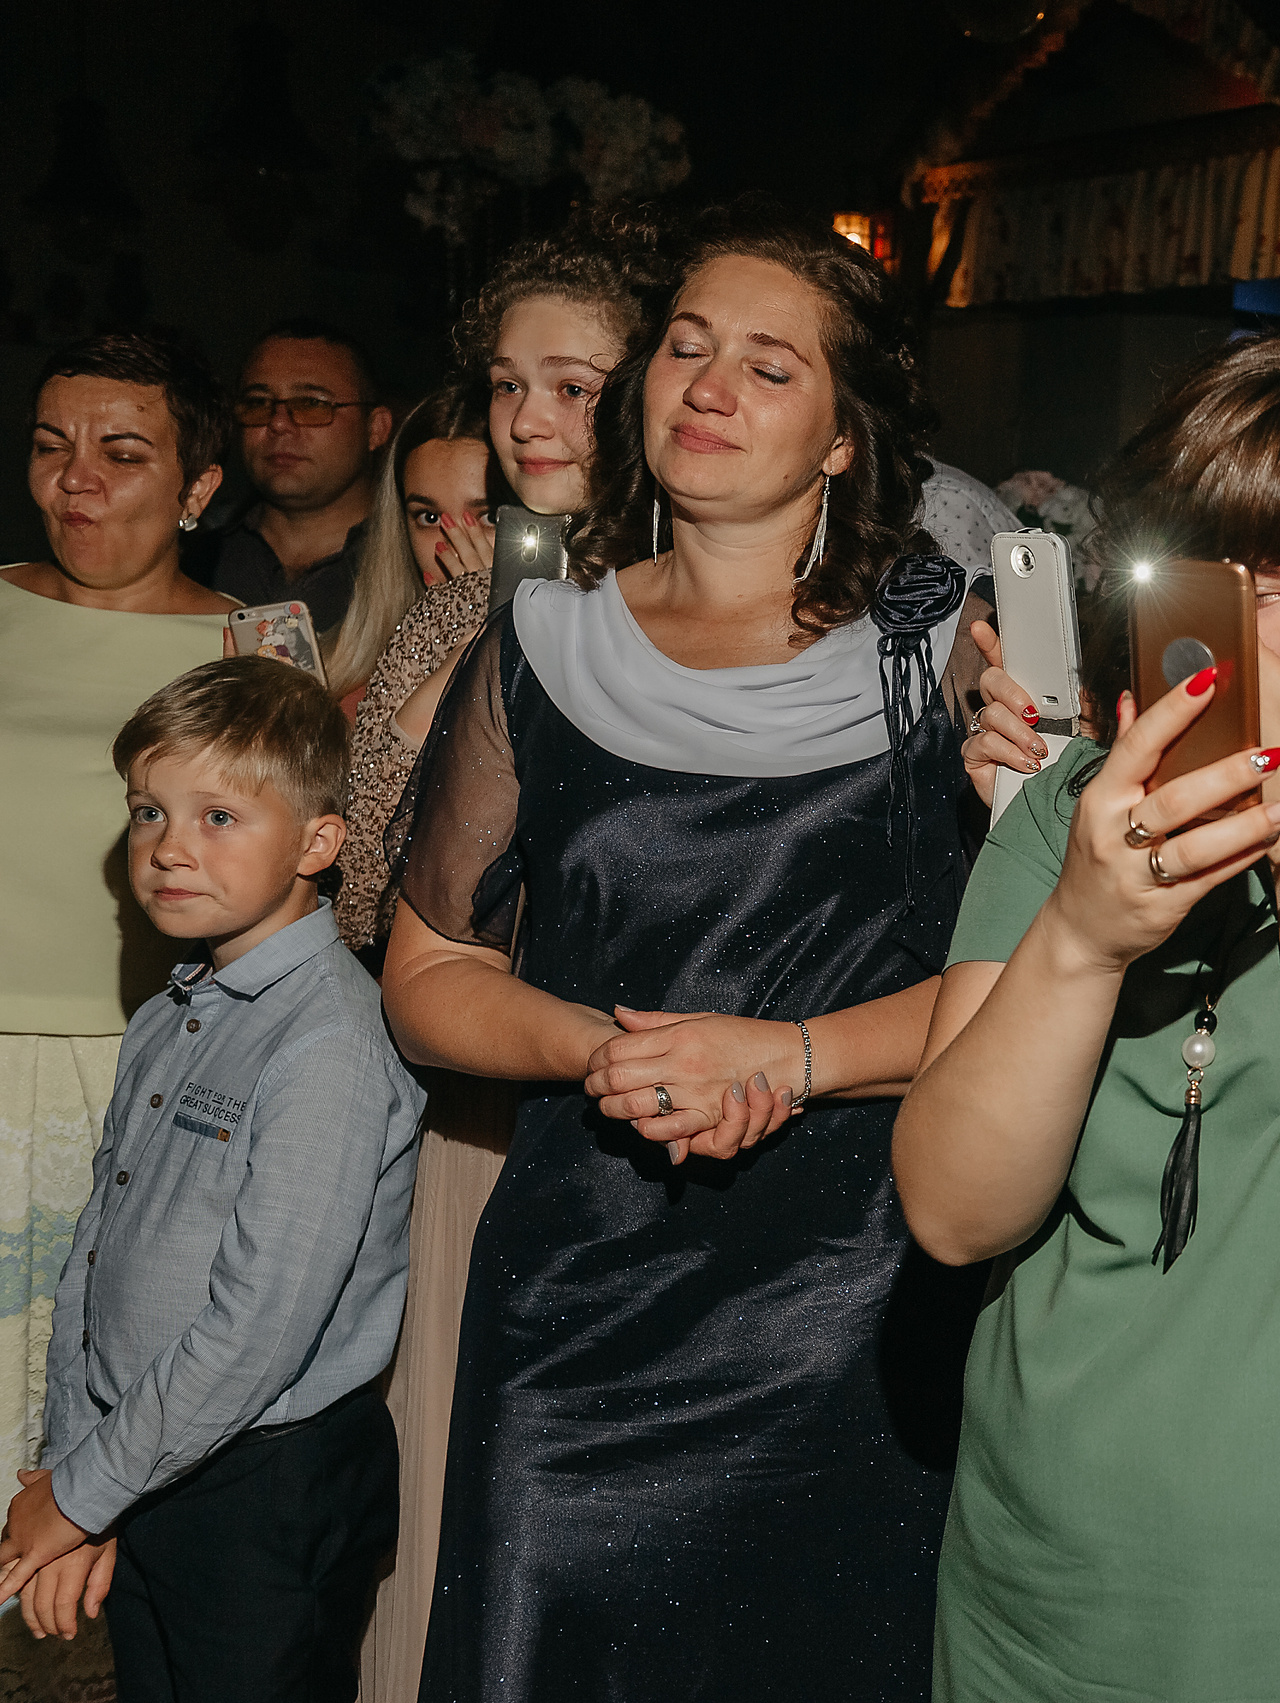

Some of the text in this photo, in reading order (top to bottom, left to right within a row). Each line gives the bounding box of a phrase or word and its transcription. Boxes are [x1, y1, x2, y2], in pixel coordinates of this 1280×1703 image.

[179, 1095, 204, 1111] GREAT
[185, 1082, 248, 1112] FIGHT FOR THE
